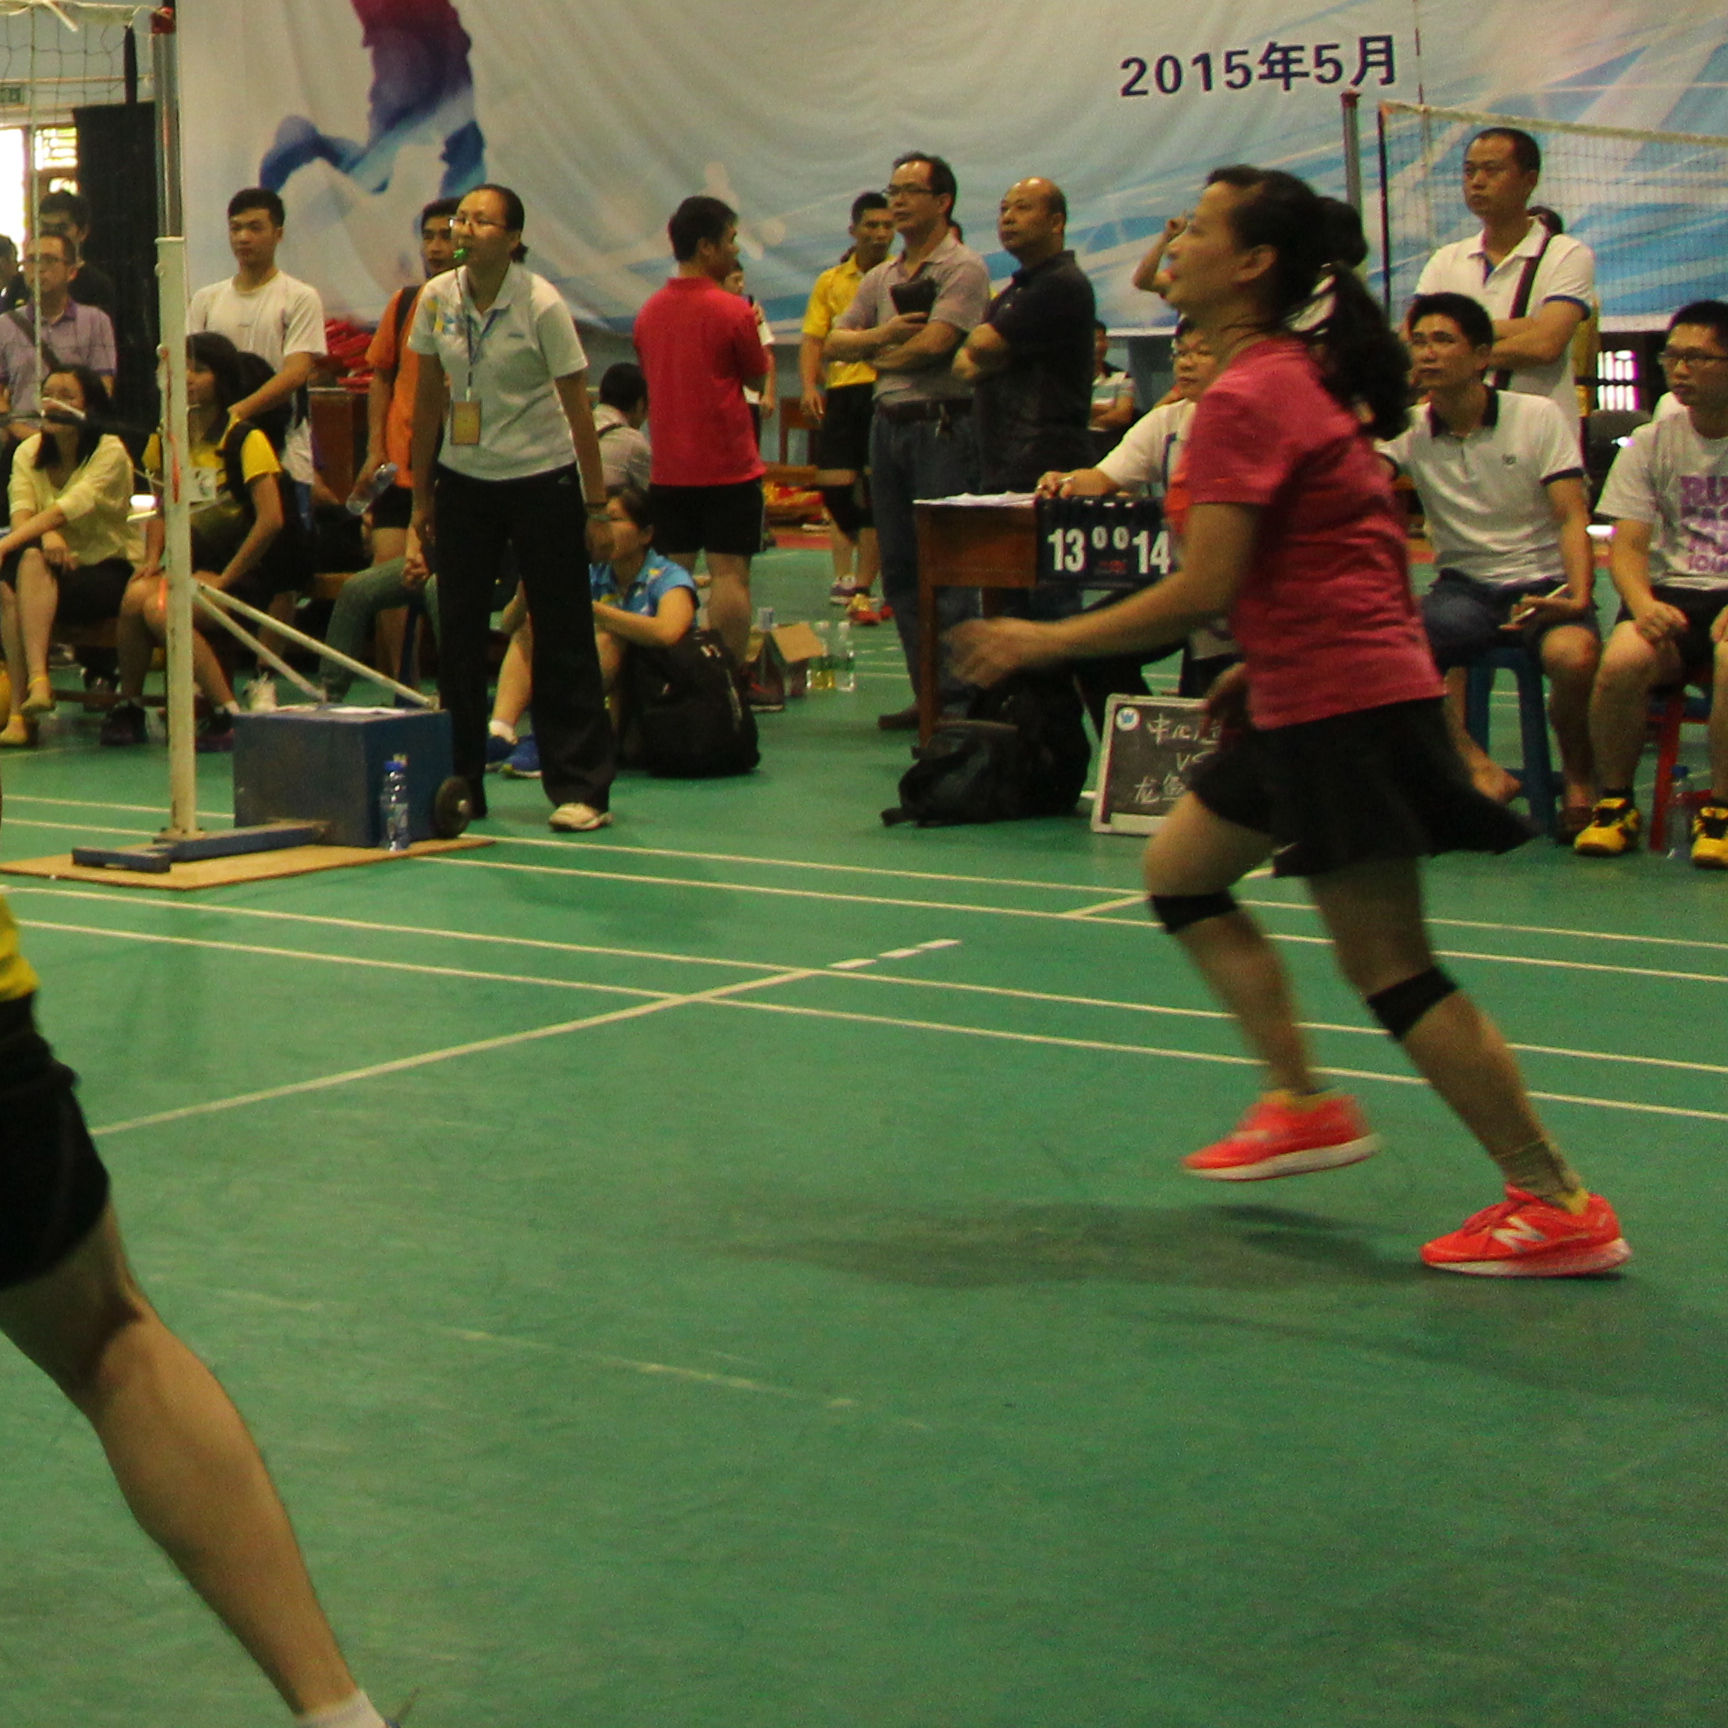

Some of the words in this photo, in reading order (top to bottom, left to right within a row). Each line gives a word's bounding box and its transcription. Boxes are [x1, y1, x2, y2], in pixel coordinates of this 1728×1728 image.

[1118, 35, 1396, 100] 2015年5月
[1047, 527, 1086, 573] 13
[1131, 529, 1172, 575] 14
